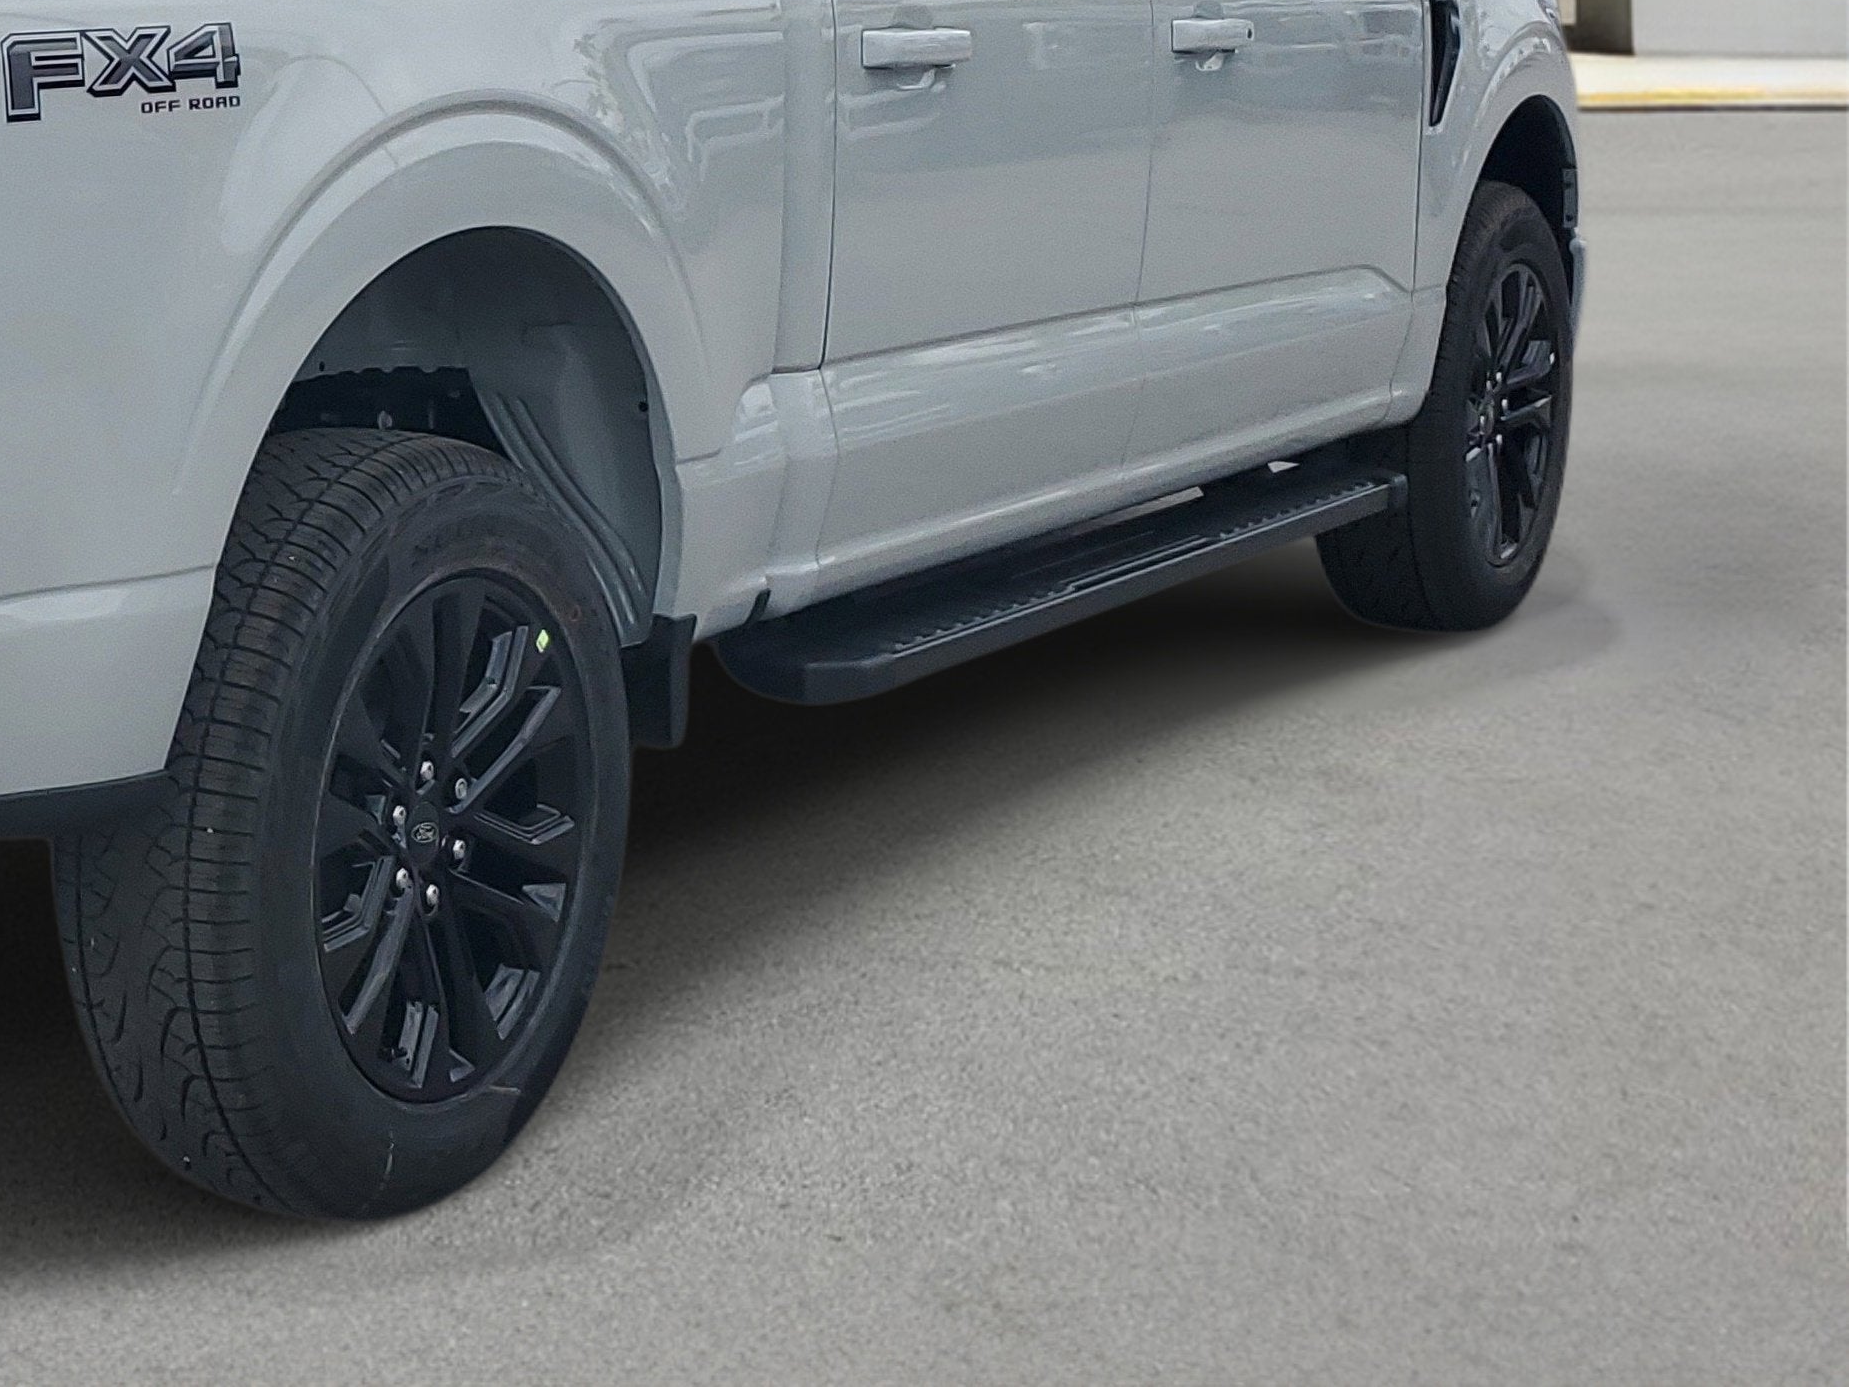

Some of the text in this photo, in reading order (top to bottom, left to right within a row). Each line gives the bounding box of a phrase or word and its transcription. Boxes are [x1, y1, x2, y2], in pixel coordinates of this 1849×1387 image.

[0, 21, 242, 124] FX4
[140, 94, 242, 114] OFF ROAD
